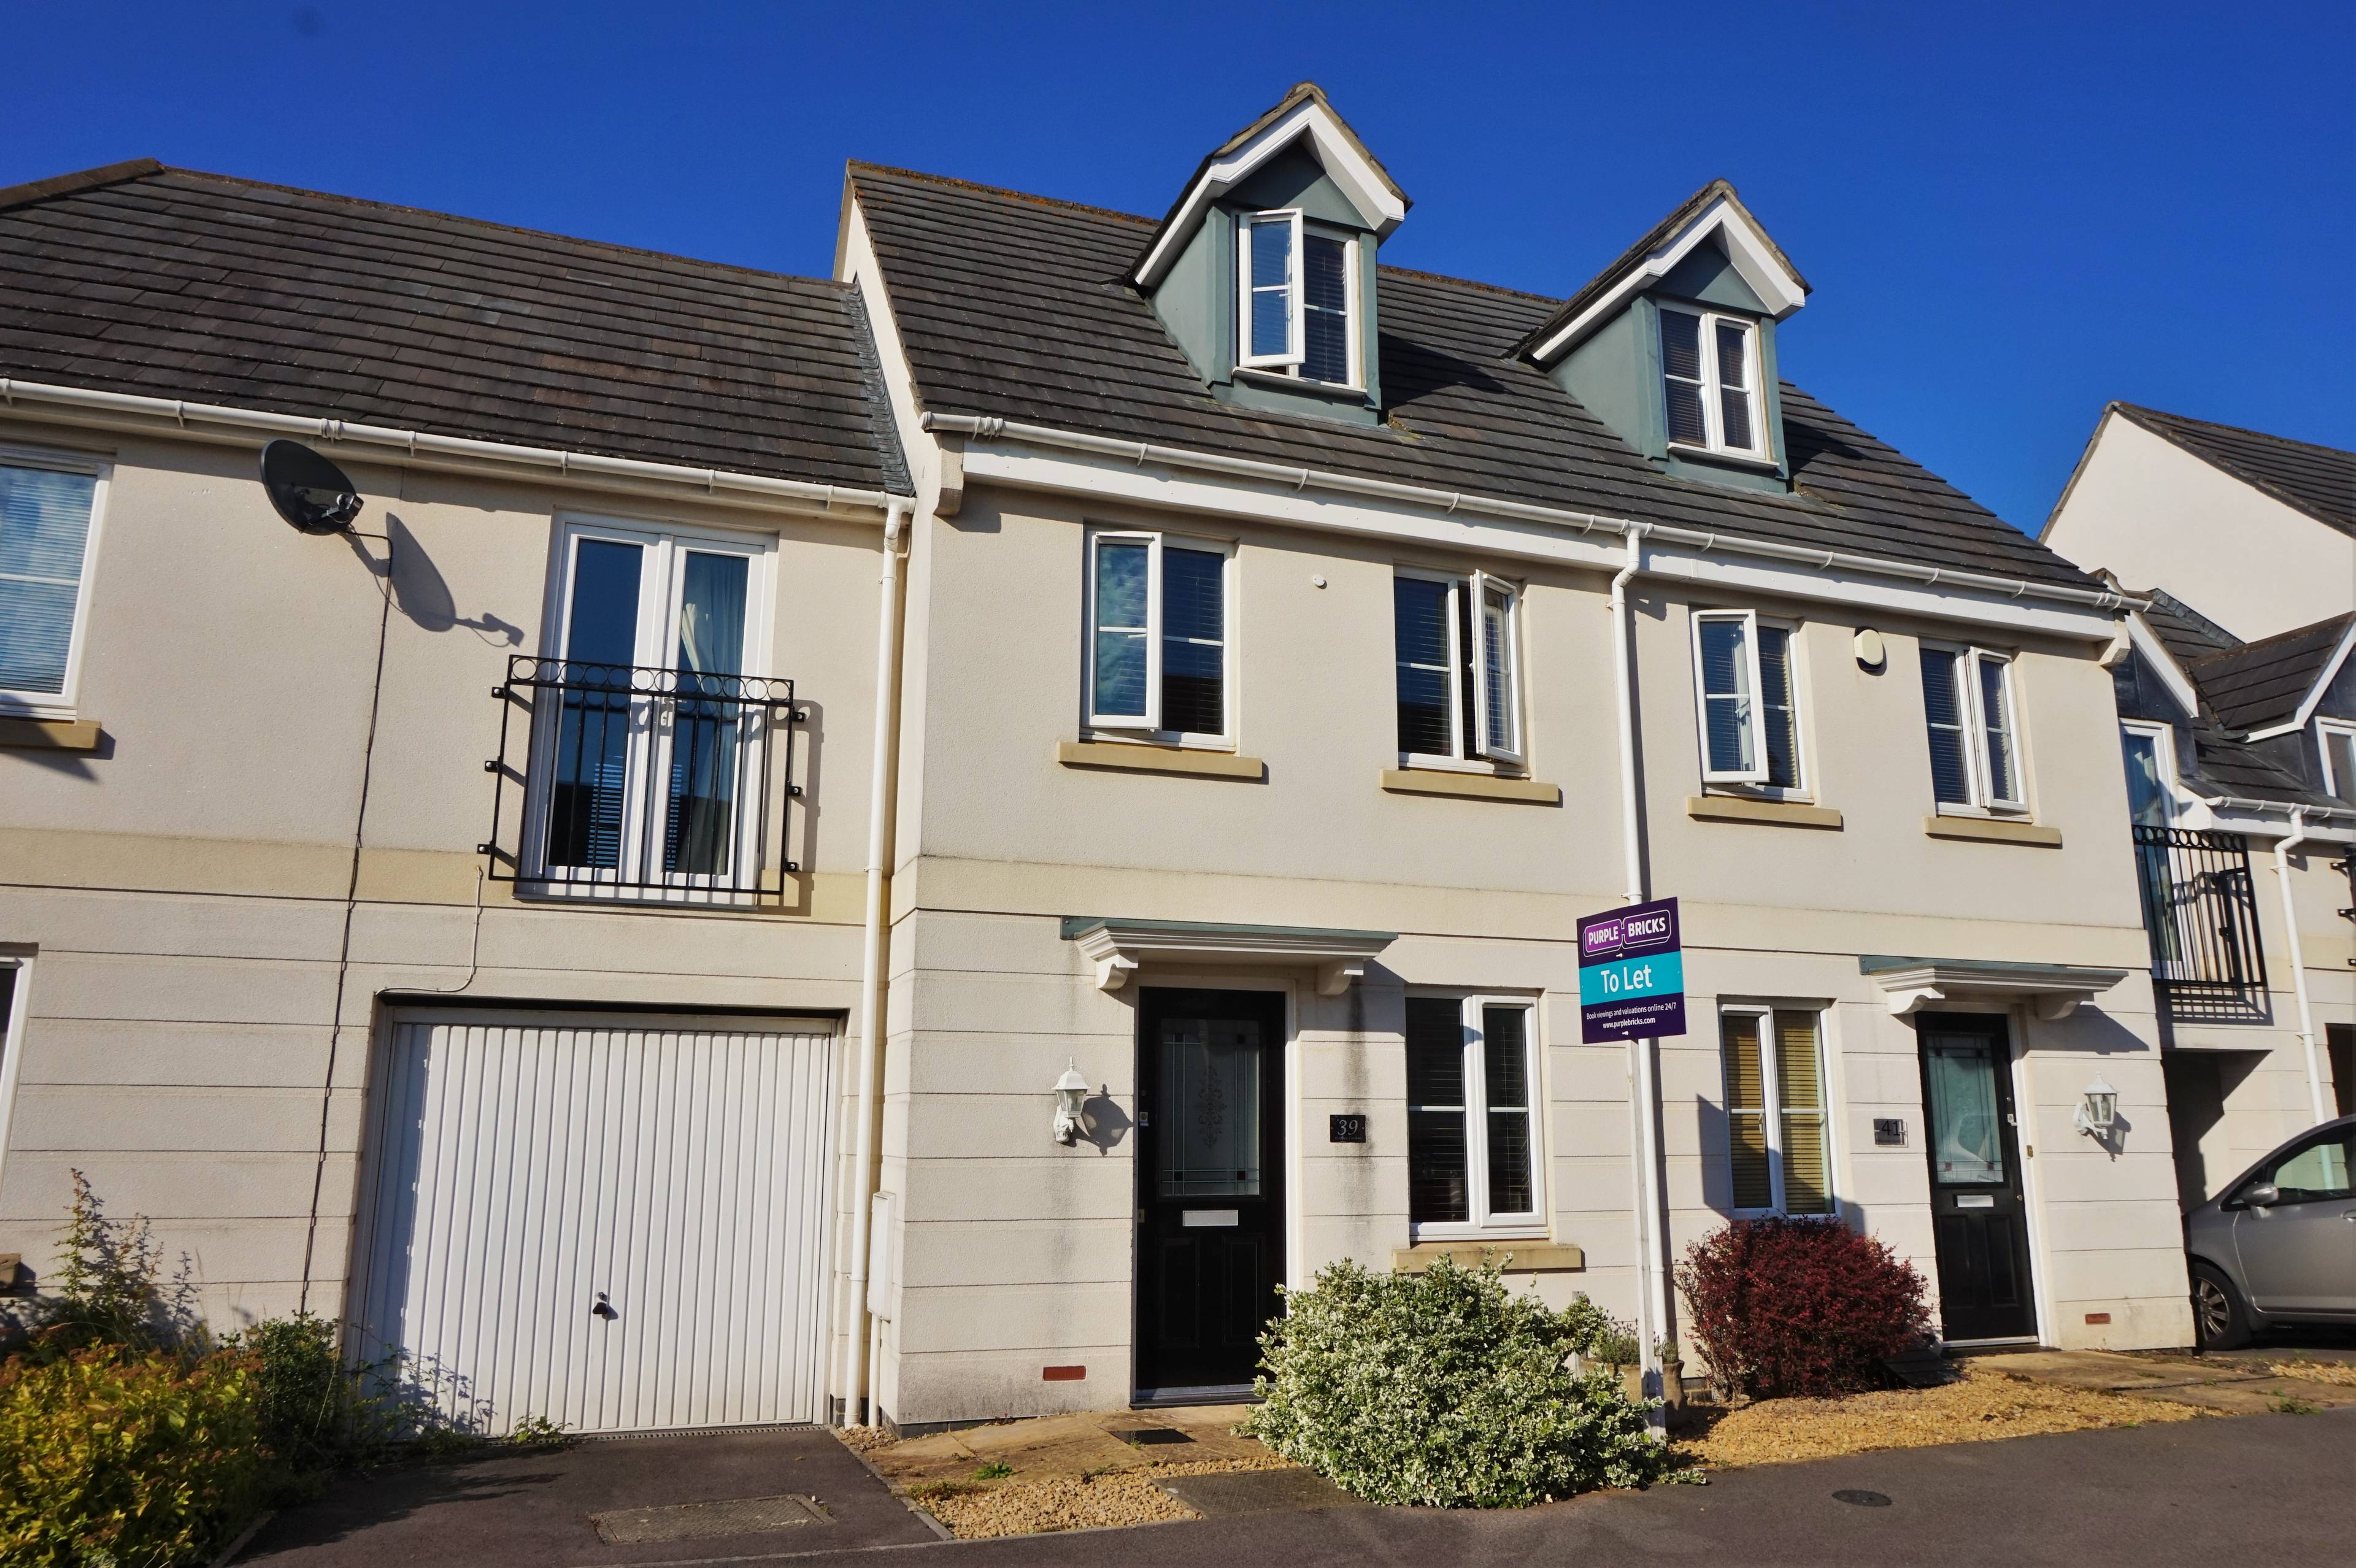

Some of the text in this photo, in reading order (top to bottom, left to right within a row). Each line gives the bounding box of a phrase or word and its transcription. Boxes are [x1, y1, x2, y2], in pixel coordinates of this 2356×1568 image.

[1588, 917, 1666, 945] PURPLE BRICKS
[1600, 964, 1653, 994] To Let
[1597, 1010, 1613, 1018] viewings
[1622, 1006, 1647, 1015] valuations
[1665, 1002, 1676, 1011] 24/7
[1603, 1018, 1656, 1029] www.purplebricks.com
[1338, 1120, 1358, 1136] 39
[1882, 1120, 1900, 1136] 41
